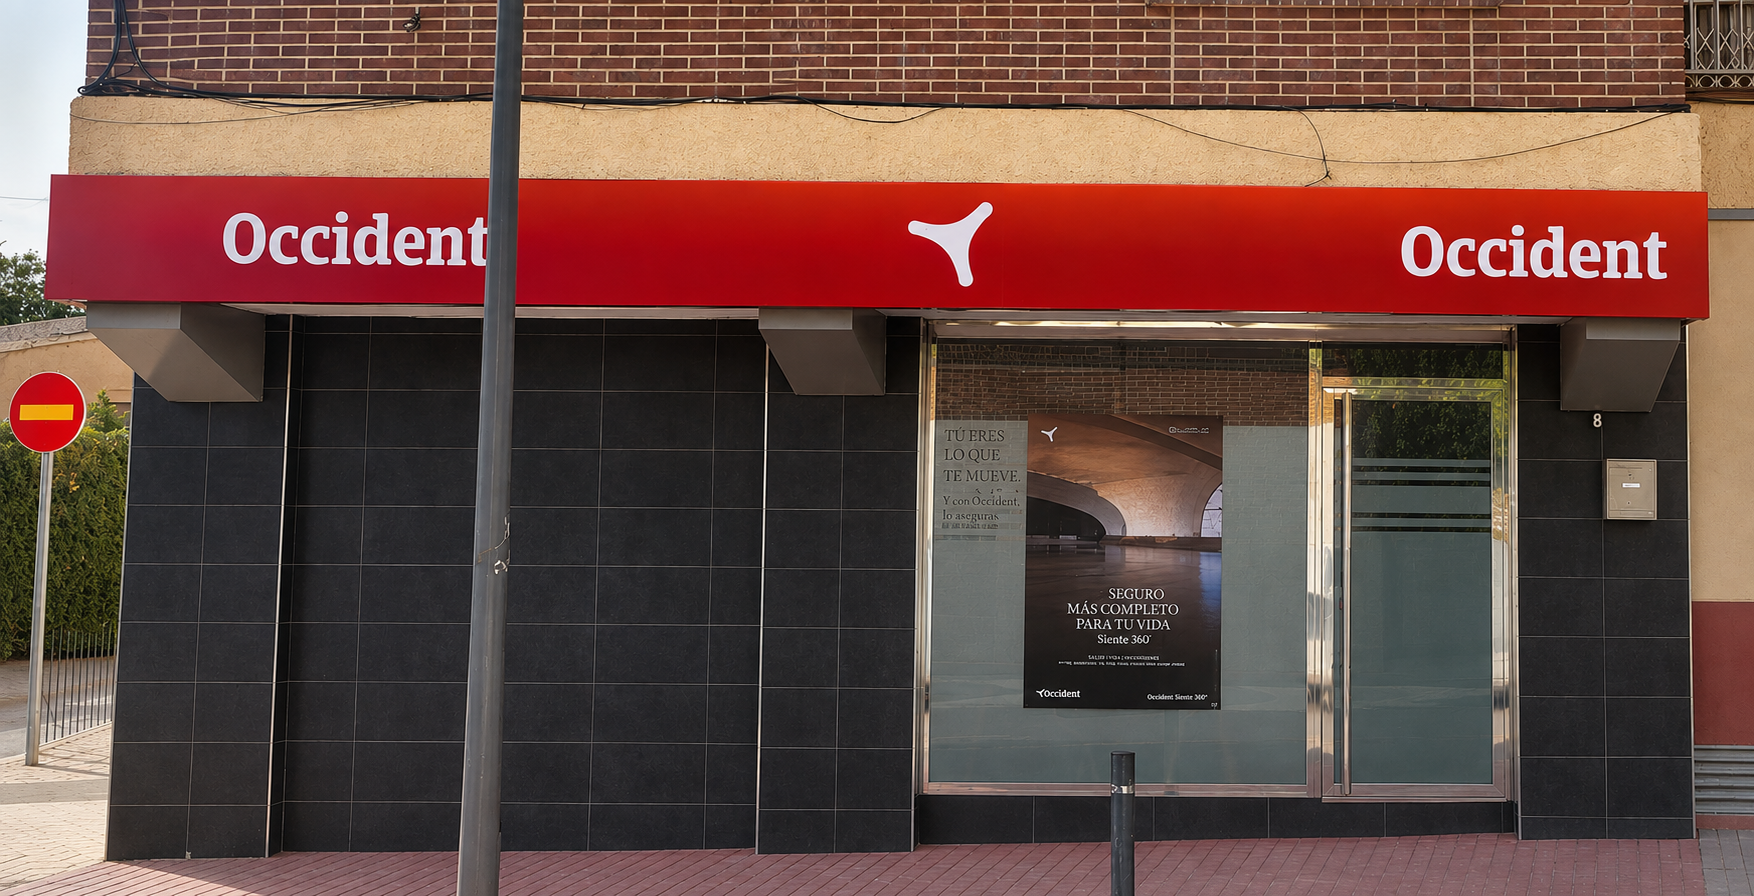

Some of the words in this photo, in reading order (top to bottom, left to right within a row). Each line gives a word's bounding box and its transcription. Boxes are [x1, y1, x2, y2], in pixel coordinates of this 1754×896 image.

[222, 211, 488, 267] Occident
[1401, 224, 1668, 280] Occident
[1593, 413, 1602, 428] 8
[943, 427, 965, 442] TÚ
[968, 429, 1005, 442] ERES
[944, 448, 965, 461] LO
[968, 448, 1001, 464] QUE
[943, 469, 962, 482] TE
[966, 469, 1021, 482] MUEVE.
[943, 495, 951, 505] Y
[952, 498, 970, 506] con
[972, 495, 1020, 507] Occident,
[942, 509, 953, 520] lo
[955, 512, 999, 523] aseguras
[1108, 587, 1165, 600] SEGURO
[1067, 600, 1098, 615] MÁS
[1100, 603, 1179, 616] COMPLETO
[1076, 618, 1112, 630] PARA
[1114, 618, 1134, 630] TU
[1136, 618, 1171, 631] VIDA
[1097, 634, 1129, 645] Siente
[1043, 689, 1081, 698] Occident
